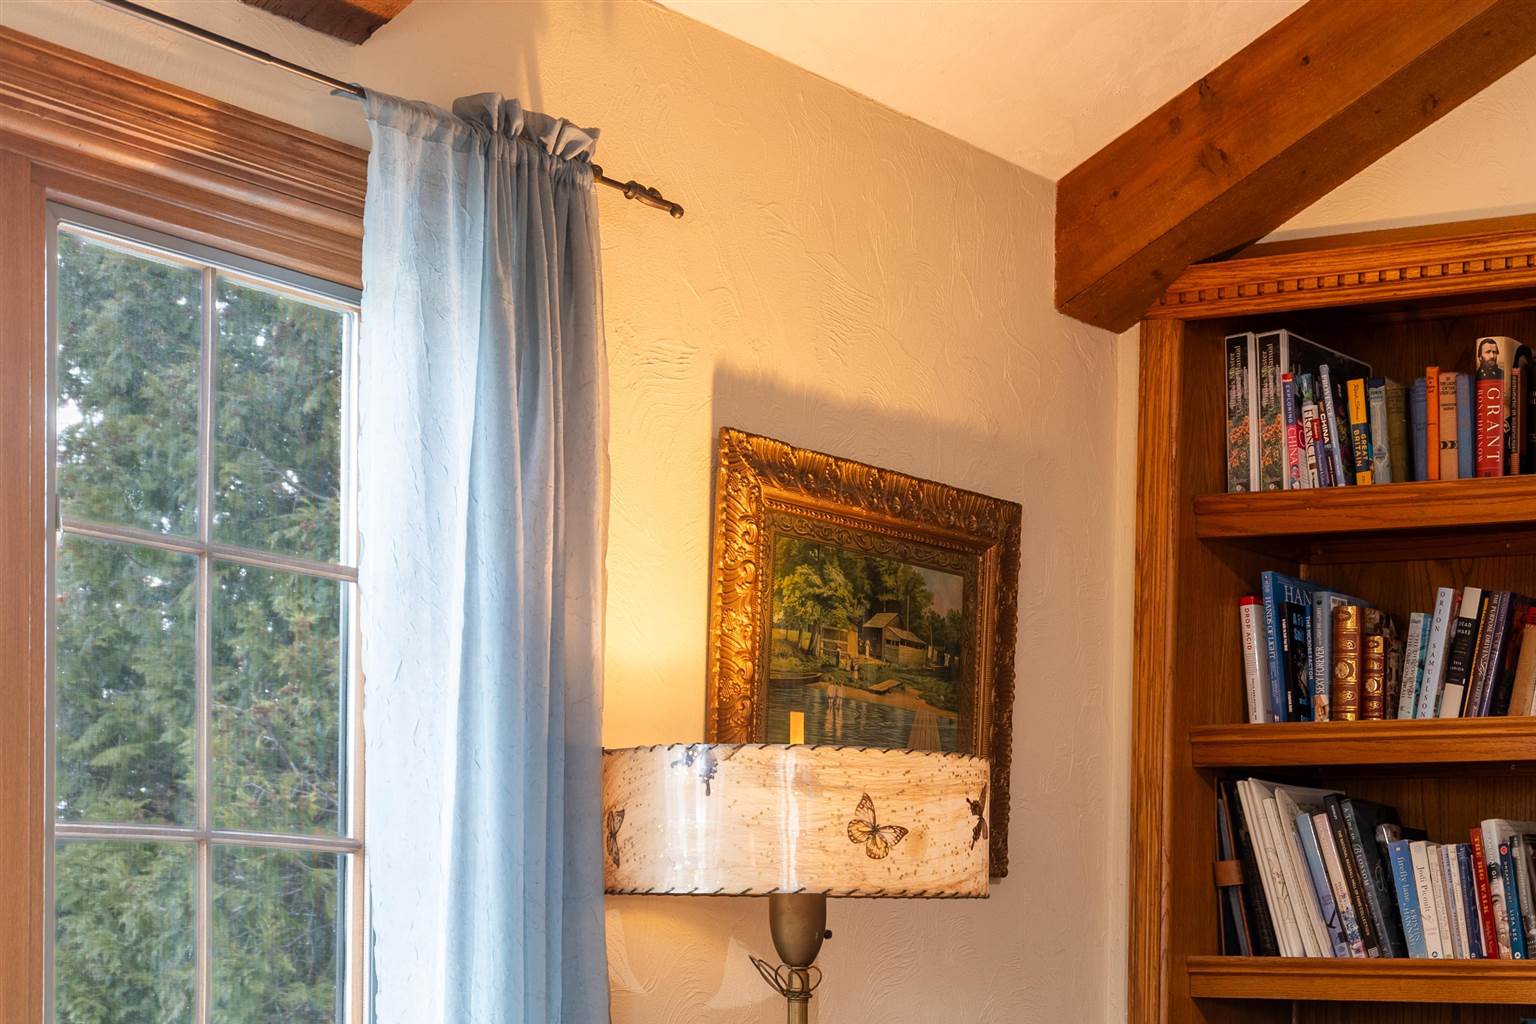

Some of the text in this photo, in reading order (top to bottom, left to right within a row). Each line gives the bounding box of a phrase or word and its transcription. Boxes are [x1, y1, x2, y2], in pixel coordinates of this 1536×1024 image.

[1286, 384, 1294, 424] EXPLORING
[1321, 374, 1333, 418] PROVENCE
[1319, 413, 1330, 444] CHINA
[1486, 387, 1500, 462] GRANT
[1287, 427, 1299, 465] CHINA
[1353, 430, 1363, 467] BRITAIN
[1360, 433, 1369, 461] GREAT
[1284, 585, 1312, 606] HAN
[1265, 597, 1274, 625] HANDS
[1435, 591, 1446, 632] ORION
[1486, 606, 1497, 633] PURPOSE
[1268, 636, 1276, 660] LIGHT
[1481, 634, 1492, 660] DRIVEN
[1316, 651, 1325, 681] FOREVER
[1316, 682, 1325, 699] SEXY
[1474, 835, 1483, 858] THE
[1397, 856, 1411, 902] firefly lane
[1477, 861, 1486, 881] BIG
[1416, 865, 1431, 913] Jodi Picoult
[1480, 883, 1489, 914] WALK
